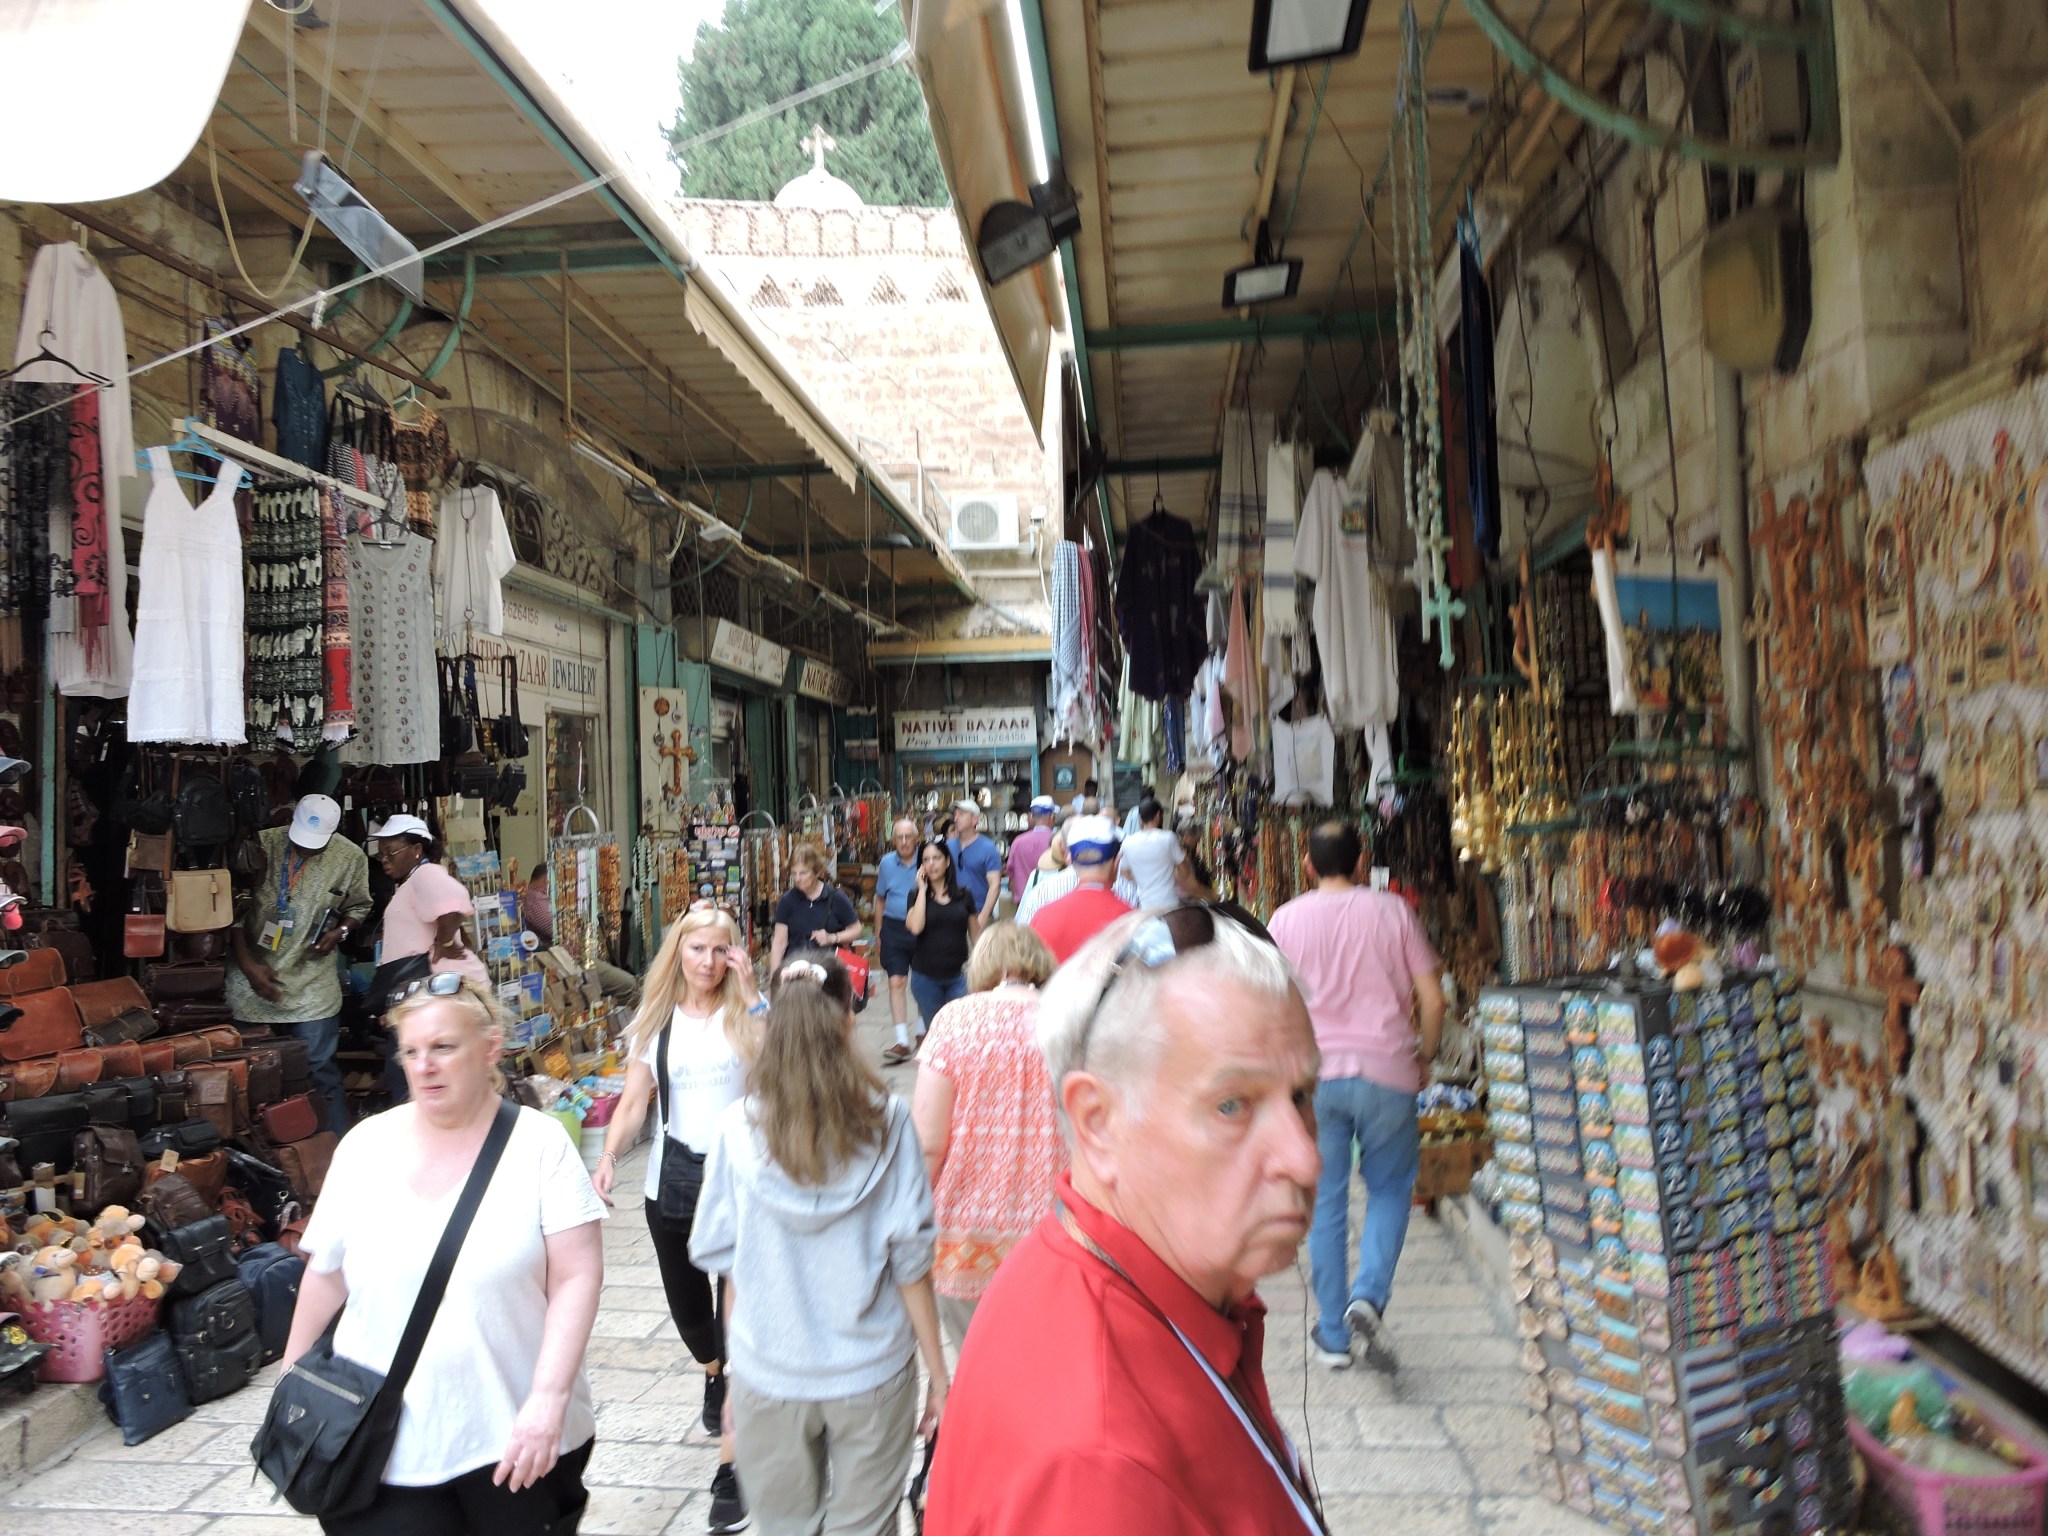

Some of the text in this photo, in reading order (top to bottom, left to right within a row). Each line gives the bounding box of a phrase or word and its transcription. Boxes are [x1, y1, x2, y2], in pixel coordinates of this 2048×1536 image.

[552, 657, 597, 697] JEWELLERY
[804, 666, 829, 696] NATIVE
[901, 717, 1030, 735] NATIVE BAZAAR
